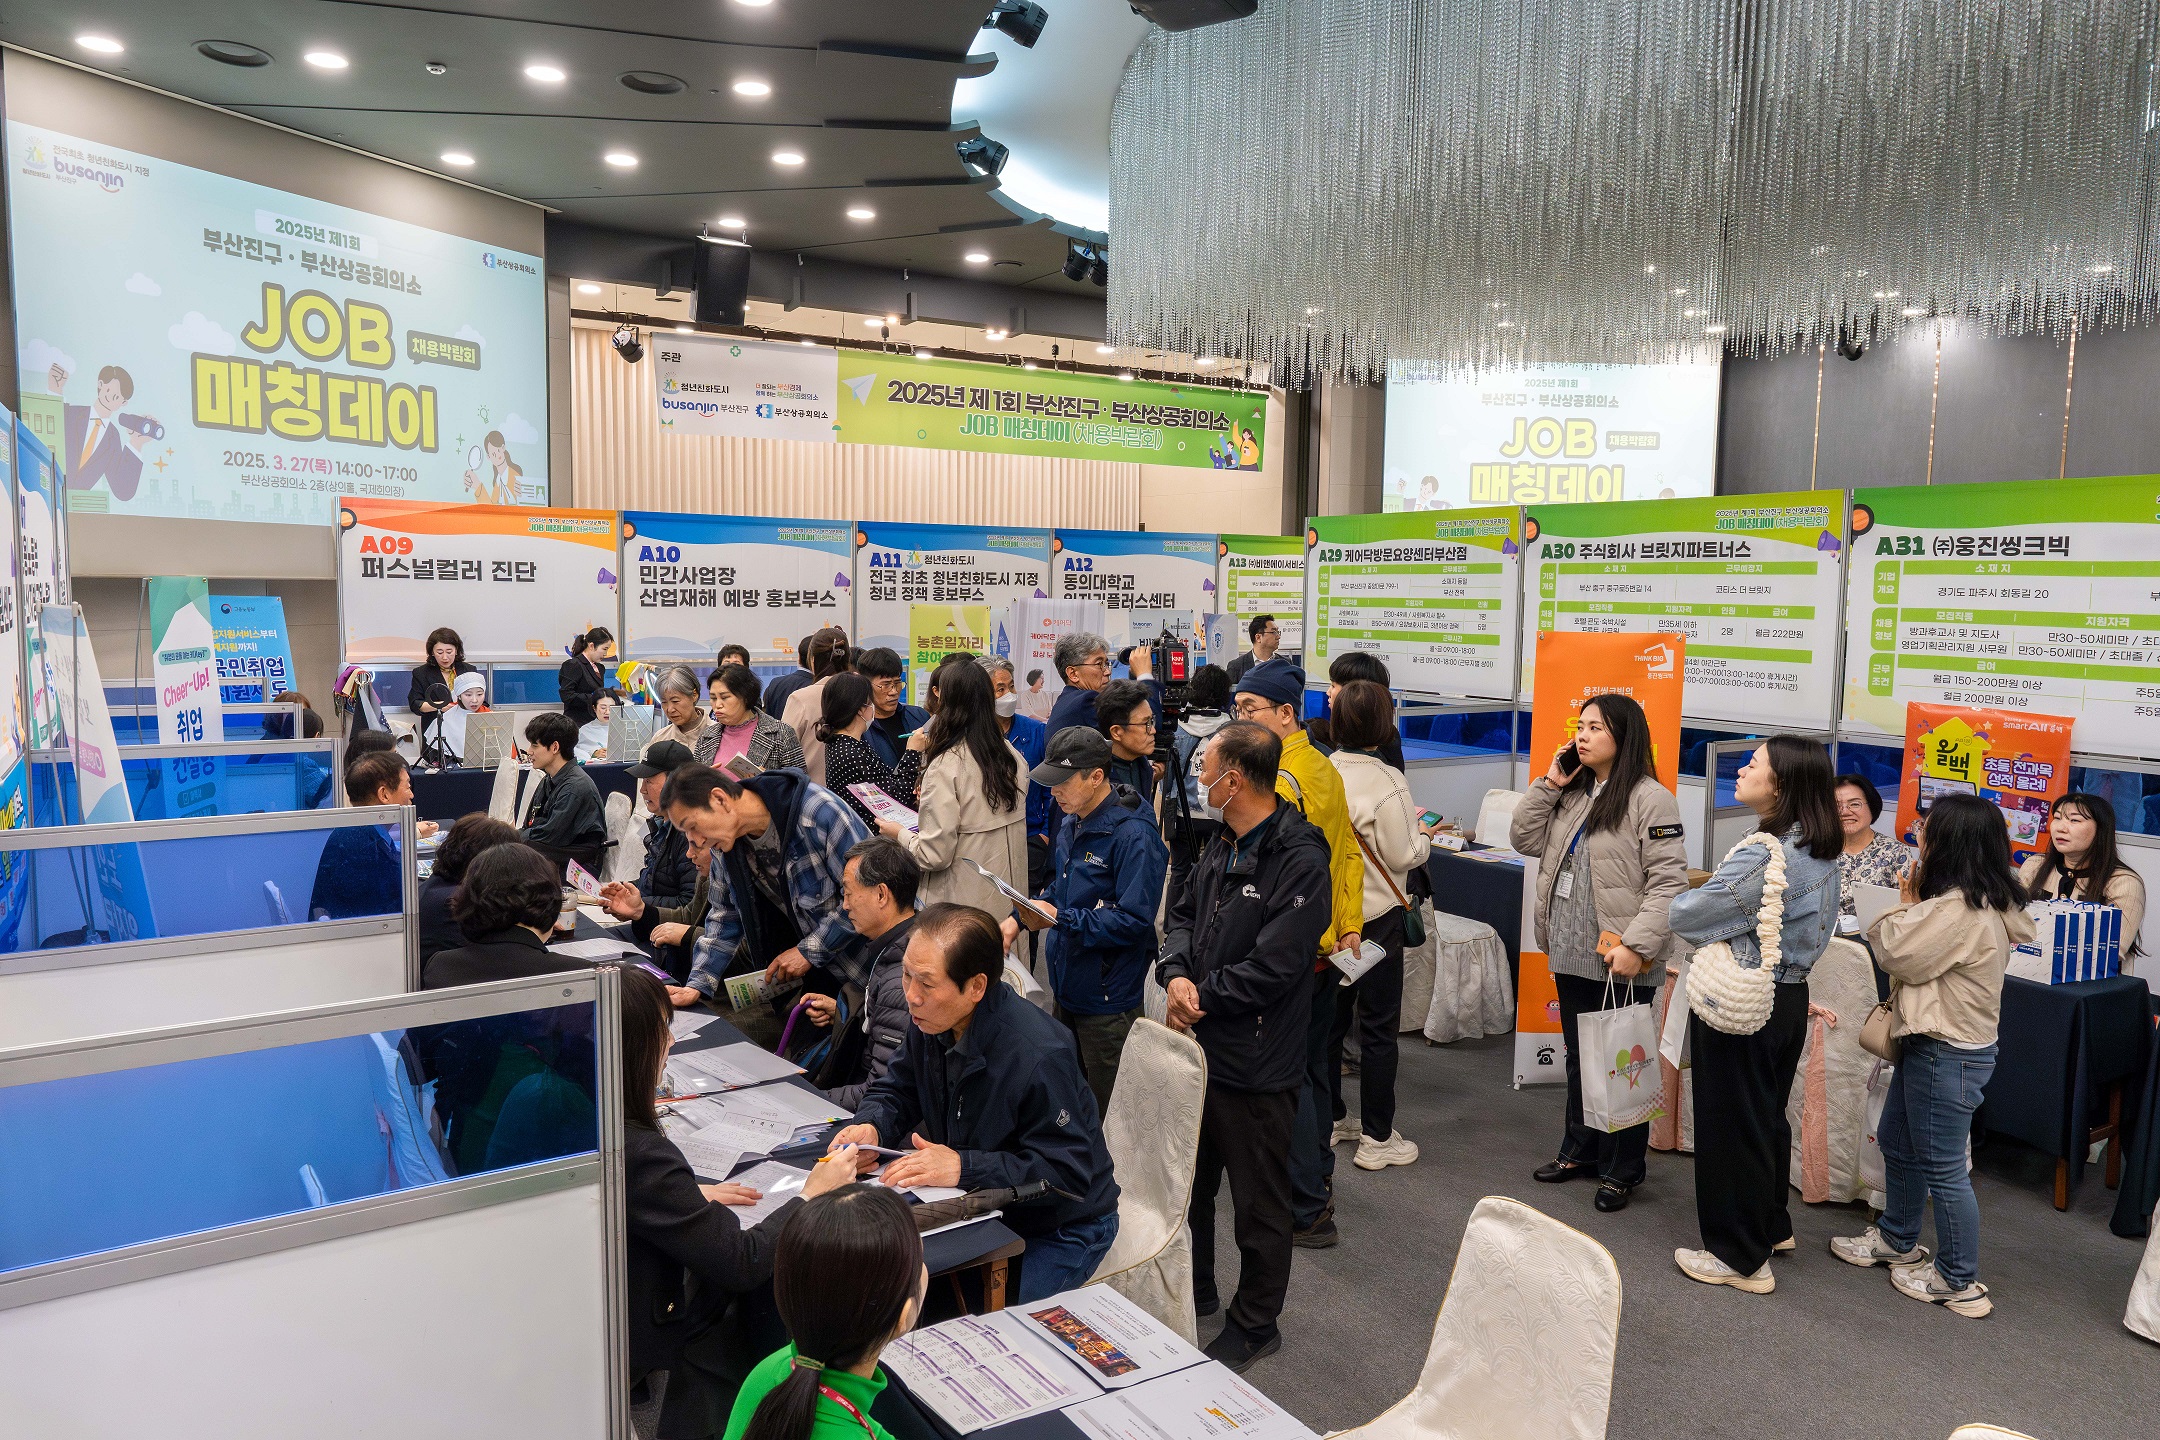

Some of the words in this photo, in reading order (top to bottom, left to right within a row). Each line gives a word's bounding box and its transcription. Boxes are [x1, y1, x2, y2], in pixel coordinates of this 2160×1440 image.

[53, 145, 85, 161] 전국최초
[87, 153, 133, 173] 청년친화도시
[134, 165, 150, 177] 지정
[54, 156, 124, 188] busanjin
[275, 218, 325, 244] 2025년
[328, 229, 361, 252] 제1회
[203, 227, 283, 266] 부산진구
[301, 249, 422, 296] 부산상공회의소
[497, 258, 536, 275] 부산상공회의소
[243, 284, 394, 368] JOB
[411, 335, 476, 365] 채용박람회
[661, 351, 682, 363] 주관
[680, 382, 729, 394] 청년친화도시
[1524, 378, 1555, 389] 2025년
[1557, 378, 1579, 389] 제1회
[193, 355, 437, 451] 매칭데이
[777, 392, 819, 401] 부산상공회의소
[1481, 392, 1528, 407] 부산진구
[1538, 393, 1620, 409] 부산상공회의소
[662, 398, 719, 413] busanjin
[720, 404, 749, 413] 부산진구
[887, 379, 965, 409] 2025년
[1024, 392, 1101, 421] 부산진구
[1111, 401, 1230, 432] 부산상공회의소
[775, 408, 829, 419] 부산상공회의소
[960, 414, 999, 437] JOB
[1003, 416, 1071, 443] 매칭데이
[1073, 421, 1163, 450] (채용박람회)
[1501, 418, 1596, 457] JOB
[1608, 434, 1657, 447] 채용박람회
[223, 450, 269, 470] 2025.
[273, 455, 287, 471] 3.
[290, 456, 333, 476] 27(목)
[335, 460, 418, 482] 14:00~17:00
[240, 473, 308, 491] 부산상공회의소
[359, 483, 405, 498] 국제회의장)
[1471, 462, 1623, 504] 매칭데이
[1715, 509, 1739, 517] 2025년
[1758, 508, 1783, 516] 부산진구
[1785, 506, 1829, 515] 부산상공회의소
[528, 524, 544, 532] JOB
[1715, 518, 1735, 530] JOB
[1737, 517, 1775, 530] 매칭데이
[1775, 515, 1829, 529] (채용박람회)
[1436, 528, 1449, 537] JOB
[359, 535, 414, 556] A09
[1540, 543, 1576, 560] A30
[1579, 543, 1636, 560] 주식회사
[1640, 541, 1752, 559] 브릿지파트너스
[1875, 536, 1926, 556] A31
[638, 545, 681, 563] A10
[869, 552, 903, 568] A11
[924, 554, 975, 566] 청년친화도시
[1318, 548, 1343, 562] A29
[1344, 546, 1468, 563] 케어닥방문요양센터부산점
[361, 557, 483, 582] 퍼스널컬러
[491, 560, 537, 583] 진단
[1063, 557, 1093, 572] A12
[1228, 558, 1247, 567] A13
[1725, 564, 1763, 573] 근무예정지
[639, 565, 736, 586] 민간사업장
[869, 570, 897, 585] 전국
[901, 571, 928, 585] 최초
[932, 571, 1010, 586] 청년친화도시
[1014, 573, 1039, 586] 지정
[1063, 573, 1135, 591] 동의대학교
[1877, 572, 1896, 581] 기업
[869, 586, 897, 601] 청년
[901, 587, 928, 601] 정책
[932, 587, 984, 601] 홍보부스
[1579, 584, 1592, 592] 부산
[1644, 585, 1652, 593] 14
[1748, 586, 1772, 595] 브릿지
[1877, 585, 1895, 594] 개요
[1937, 587, 1966, 598] 경기도
[1968, 588, 1998, 598] 파주시
[2000, 588, 2031, 599] 회동길
[2034, 589, 2049, 599] 20
[639, 588, 717, 608] 산업재해
[723, 589, 761, 608] 예방
[766, 589, 836, 608] 홍보부스
[1665, 605, 1692, 614] 지원자격
[1721, 606, 1736, 615] 인원
[1772, 607, 1789, 616] 급여
[1936, 611, 1974, 621] 모집직종
[1683, 620, 1698, 629] 이하
[1875, 618, 1893, 628] 채용
[2085, 616, 2130, 627] 지원자격
[212, 629, 278, 640] 업지원서비스부터
[1720, 627, 1734, 636] 2명
[1755, 629, 1770, 638] 월급
[1772, 629, 1804, 639] 222만원
[1875, 631, 1893, 641] 정보
[1909, 626, 1956, 638] 방과후교사
[1958, 628, 1968, 638] 및
[1971, 629, 2000, 640] 지도사
[2048, 632, 2129, 646] 만30~50세미만
[916, 635, 984, 650] 농촌일자리
[1901, 640, 1976, 653] 영업기획관리지원
[1977, 643, 2008, 655] 사무원
[2018, 645, 2097, 660] 만30~50세미만
[2109, 651, 2144, 663] 초대졸
[215, 656, 286, 678] 국민취업
[1701, 659, 1727, 668] 야간근무
[1872, 664, 1891, 673] 근무
[1976, 660, 1996, 671] 급여
[1647, 672, 1674, 680] 웅진씽크빅
[1767, 673, 1798, 683] 휴게시간)
[1871, 678, 1890, 687] 조건
[1932, 673, 1951, 685] 월급
[1954, 675, 2019, 689] 150~200만원
[2021, 680, 2043, 691] 이상
[163, 666, 210, 708] Cheer-Up!
[1767, 682, 1799, 692] 휴게시간)
[1943, 690, 1962, 701] 월급
[1964, 693, 2004, 706] 200만원
[2008, 696, 2028, 707] 이상
[176, 706, 204, 743] 취업
[1936, 739, 1971, 780] 올백
[1984, 757, 2011, 773] 초등
[2012, 760, 2053, 778] 전과목
[1988, 772, 2014, 788] 성적
[2015, 775, 2047, 791] 올려!
